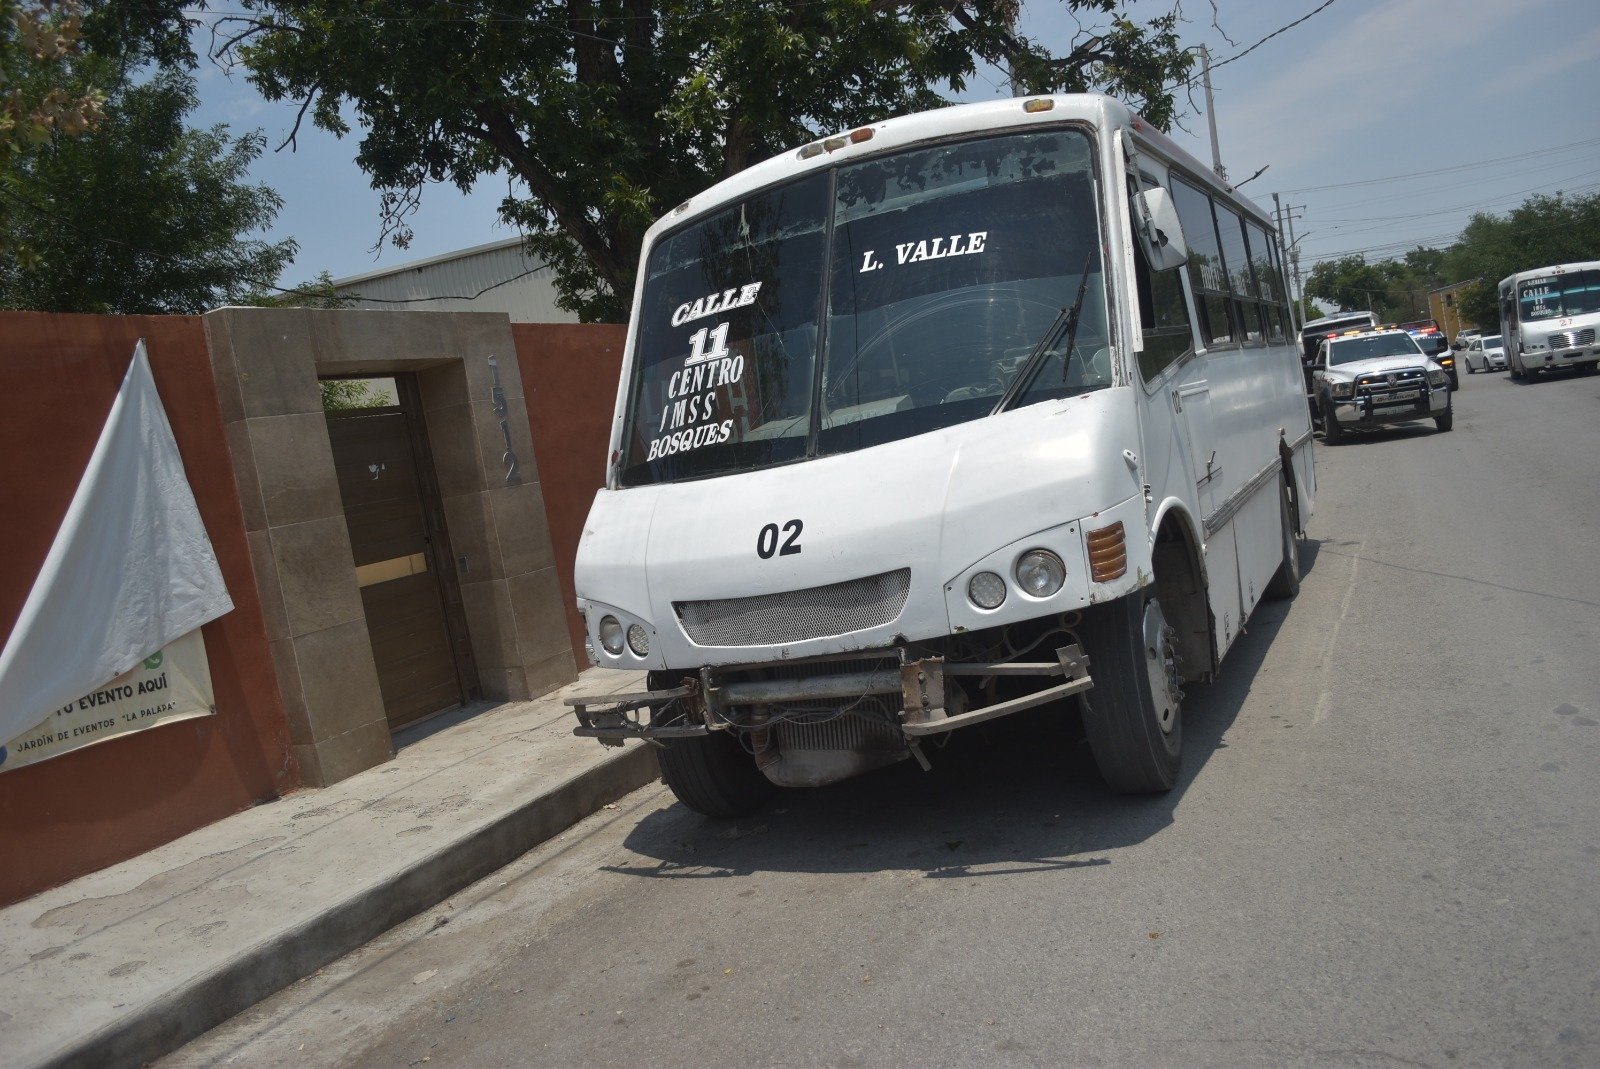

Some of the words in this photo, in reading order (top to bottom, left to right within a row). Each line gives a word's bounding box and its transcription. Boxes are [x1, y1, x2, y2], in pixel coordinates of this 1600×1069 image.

[860, 250, 884, 273] L.
[895, 231, 988, 265] VALLE
[671, 281, 763, 327] CALLE
[1523, 286, 1550, 298] CALLE
[1559, 318, 1573, 327] 27
[684, 321, 730, 367] 11
[668, 354, 745, 399] CENTRO
[659, 391, 716, 433] IMSS
[1171, 389, 1183, 415] 02
[646, 419, 734, 462] BOSQUES
[757, 518, 804, 560] 02
[78, 685, 133, 710] EVENTO
[137, 672, 168, 695] AQUÍ
[17, 734, 54, 752] JARDÍN
[57, 730, 69, 741] DE
[74, 718, 115, 737] EVENTOS
